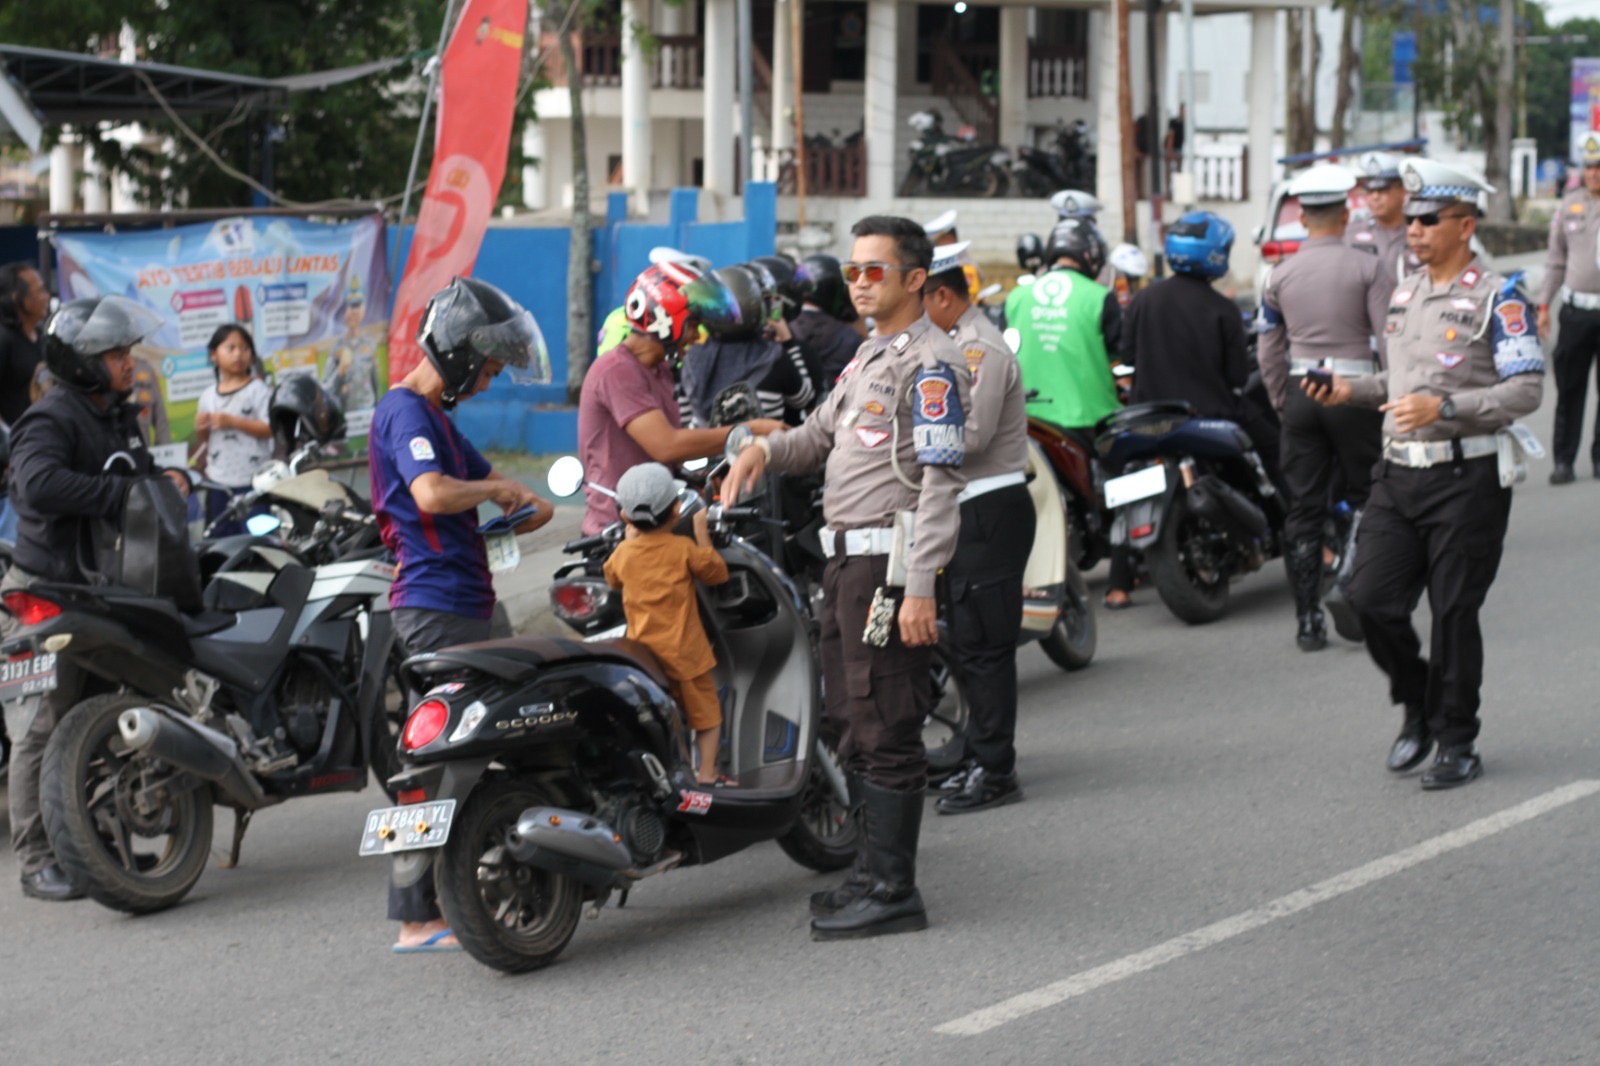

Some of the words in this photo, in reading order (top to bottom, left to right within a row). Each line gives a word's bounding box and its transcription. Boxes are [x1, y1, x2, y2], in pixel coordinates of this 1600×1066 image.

[285, 255, 339, 274] LINTAS
[1440, 311, 1474, 326] POLRI
[868, 382, 896, 397] POLRI
[1, 659, 30, 682] 3137
[33, 653, 57, 674] EBP
[495, 710, 578, 730] SCOOPY
[367, 813, 387, 833] DA
[431, 804, 448, 824] YL
